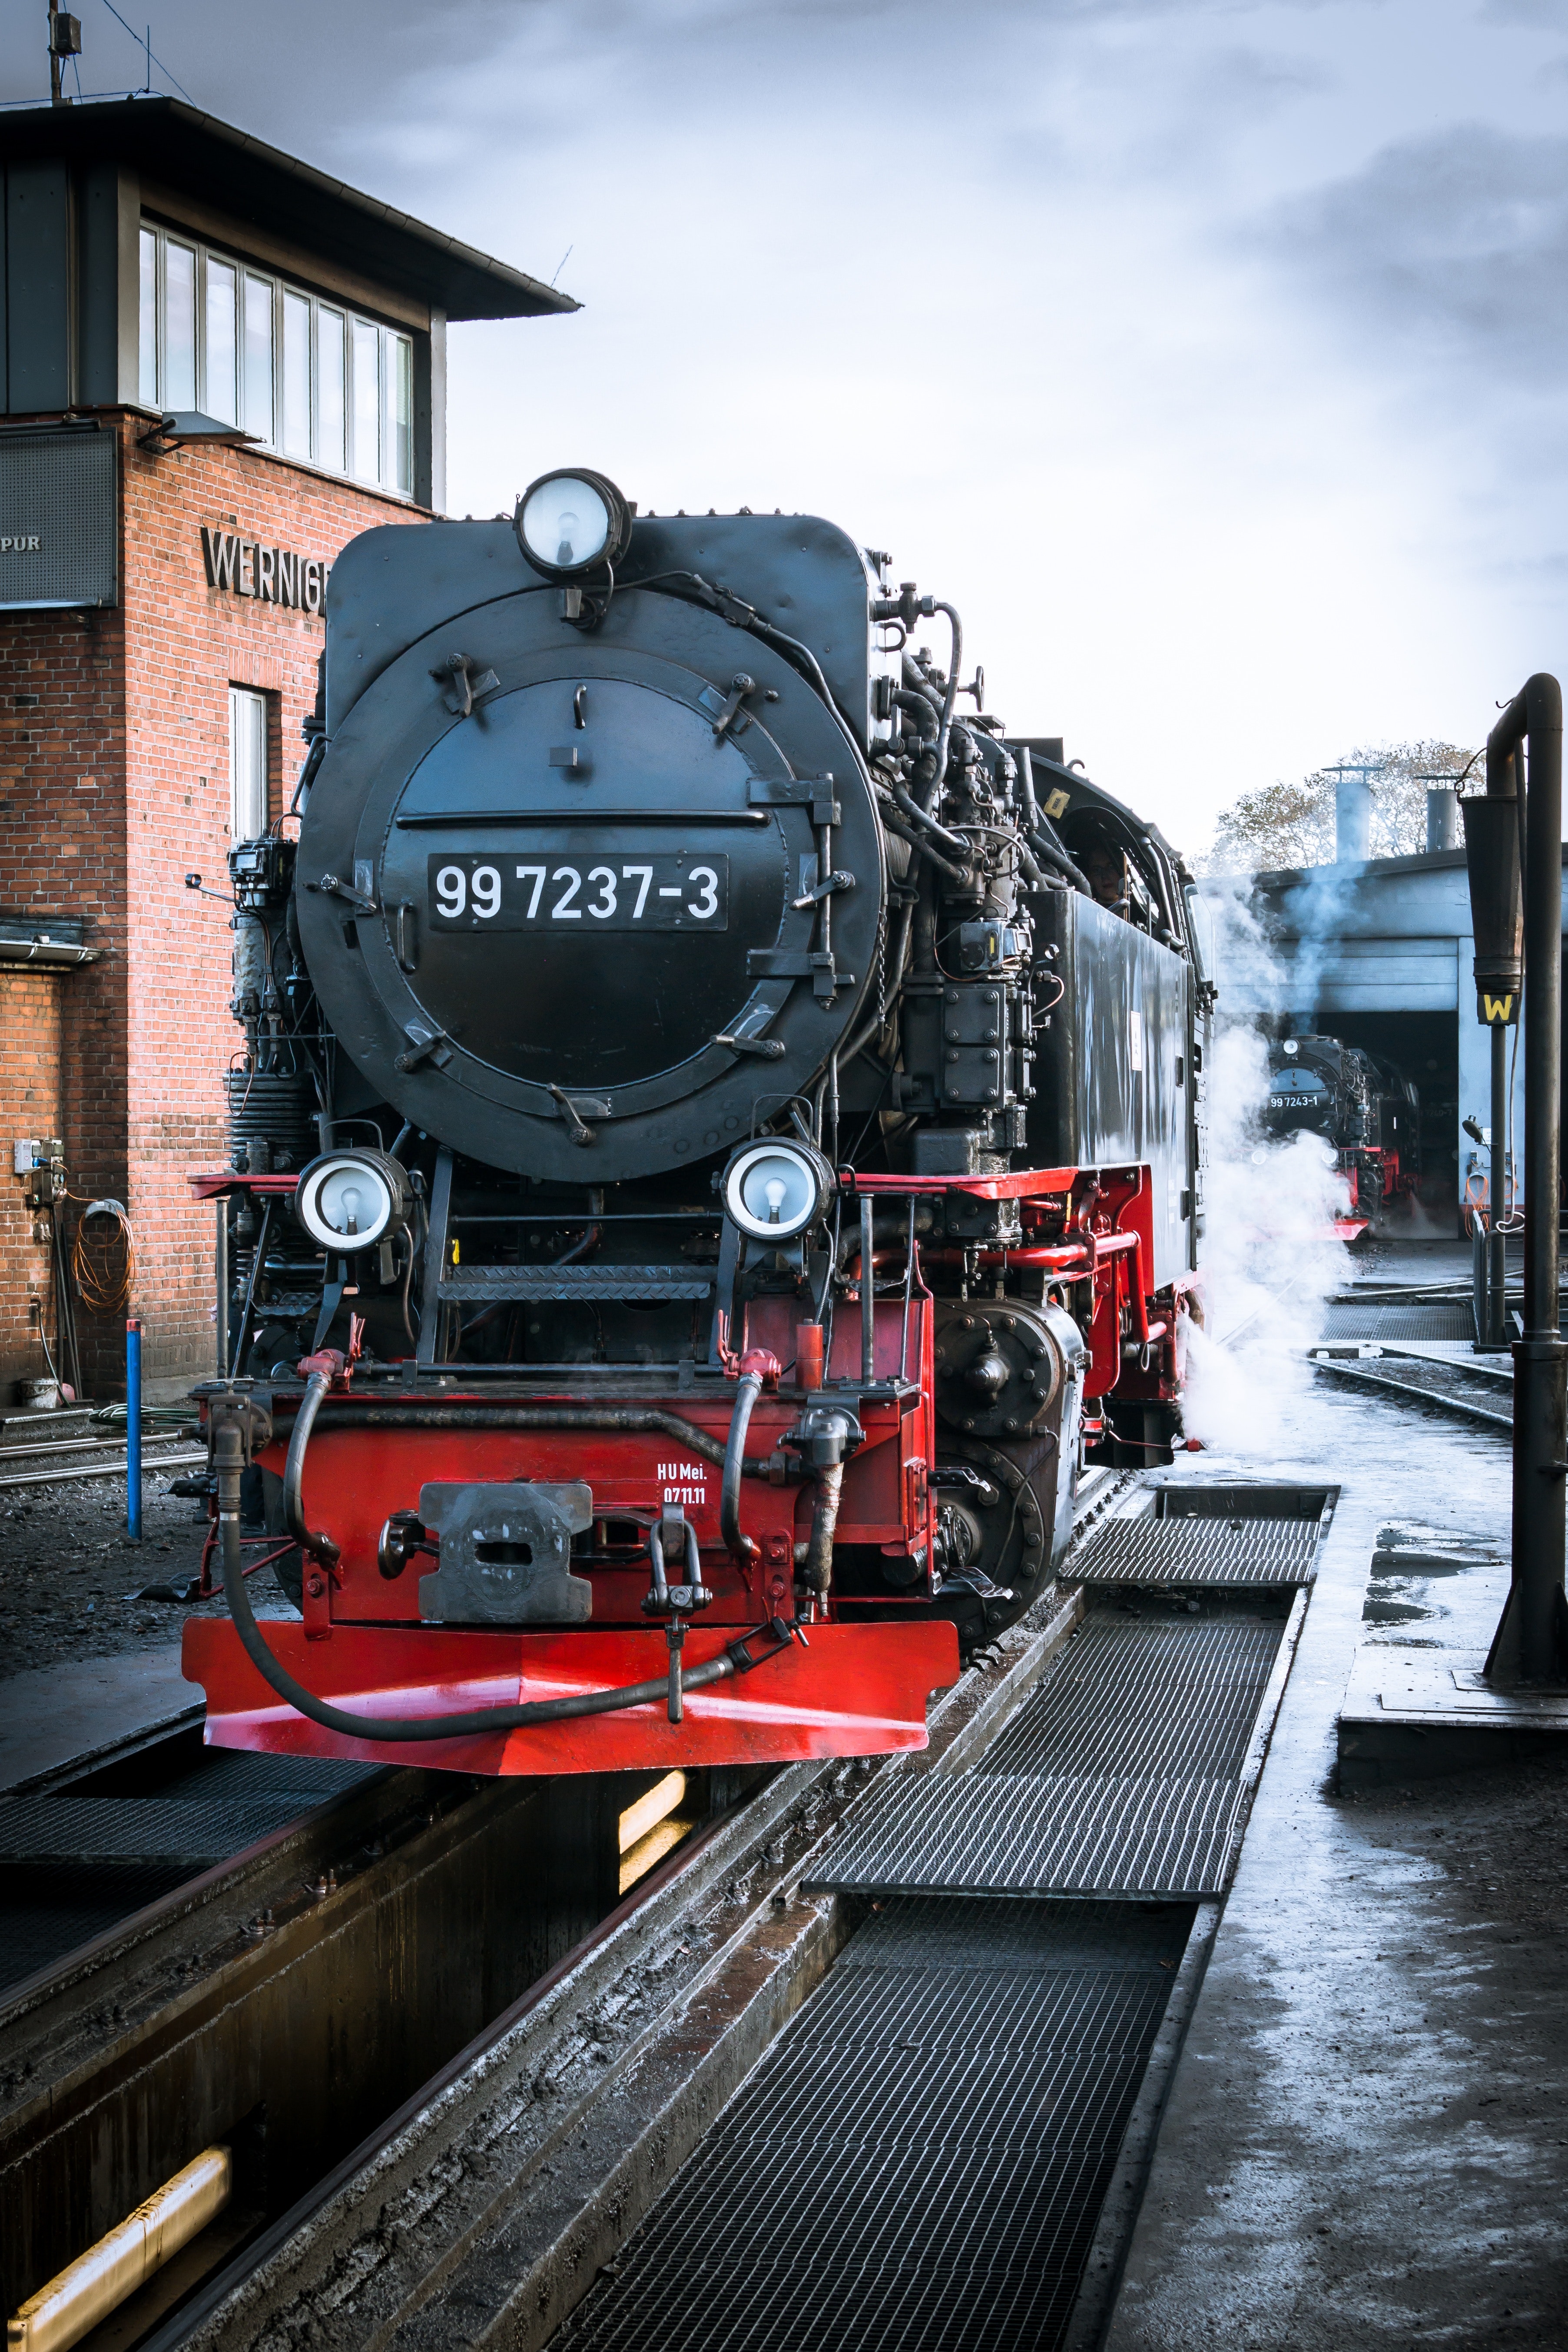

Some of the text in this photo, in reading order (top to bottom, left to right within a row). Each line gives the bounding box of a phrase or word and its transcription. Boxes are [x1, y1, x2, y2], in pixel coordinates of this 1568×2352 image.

[0, 536, 42, 552] PUR
[436, 866, 718, 918] 99 7237-3
[1484, 994, 1512, 1021] W
[1271, 1095, 1317, 1107] 99 7243-1
[657, 1463, 707, 1480] HU Mei.
